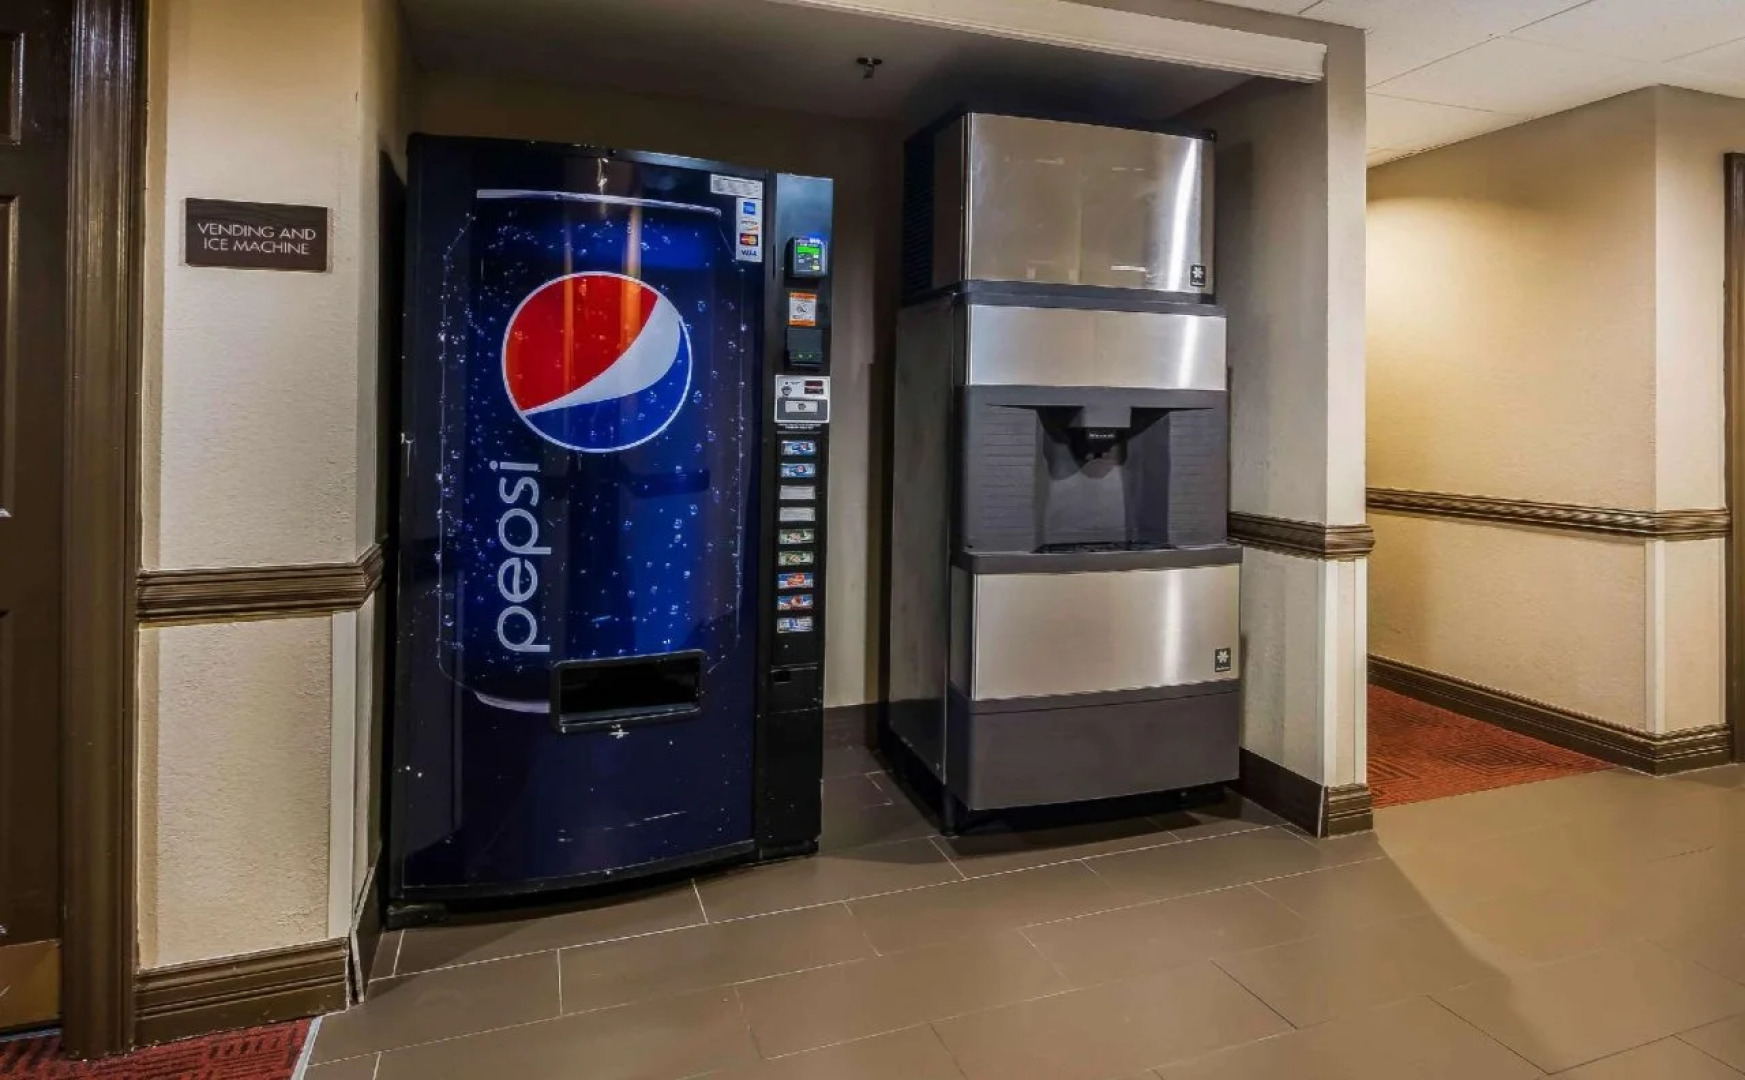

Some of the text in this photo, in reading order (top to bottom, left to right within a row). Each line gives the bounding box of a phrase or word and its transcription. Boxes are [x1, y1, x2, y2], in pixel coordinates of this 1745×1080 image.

[198, 222, 316, 240] VENDING AND
[203, 237, 311, 255] ICE MACHINE
[489, 459, 552, 653] pepsi
